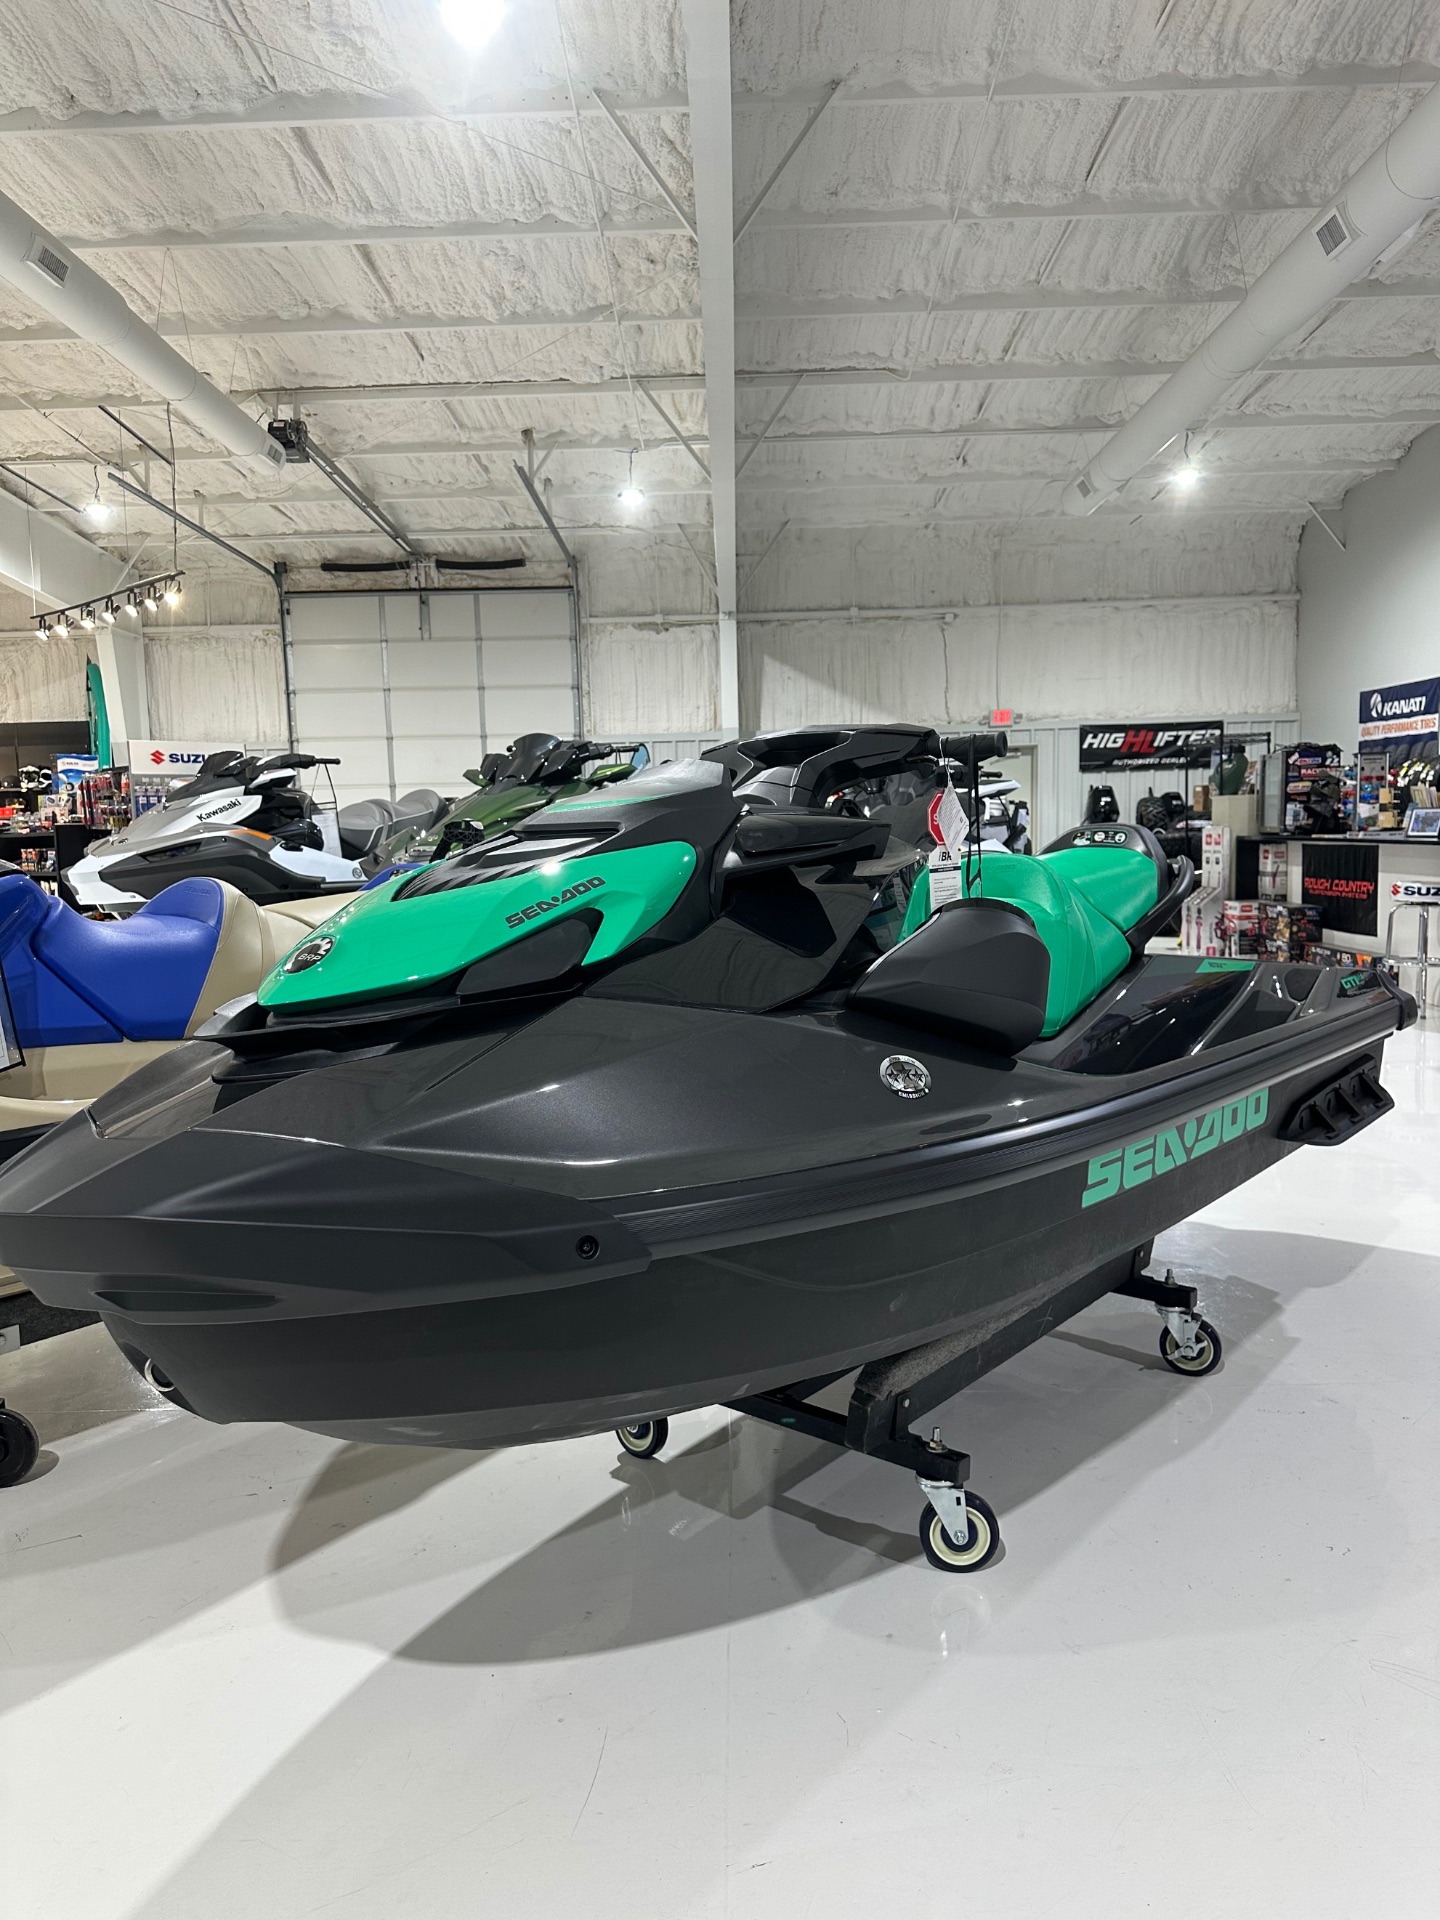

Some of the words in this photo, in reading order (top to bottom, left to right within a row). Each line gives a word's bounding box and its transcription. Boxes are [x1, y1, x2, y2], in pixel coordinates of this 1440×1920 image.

[1382, 695, 1426, 717] KANATI
[1112, 757, 1160, 766] AUTHORIZED
[196, 798, 242, 822] Kawasaki
[1303, 877, 1330, 890] ROUGH
[1332, 879, 1375, 894] COUNTRY
[297, 953, 322, 961] BRP
